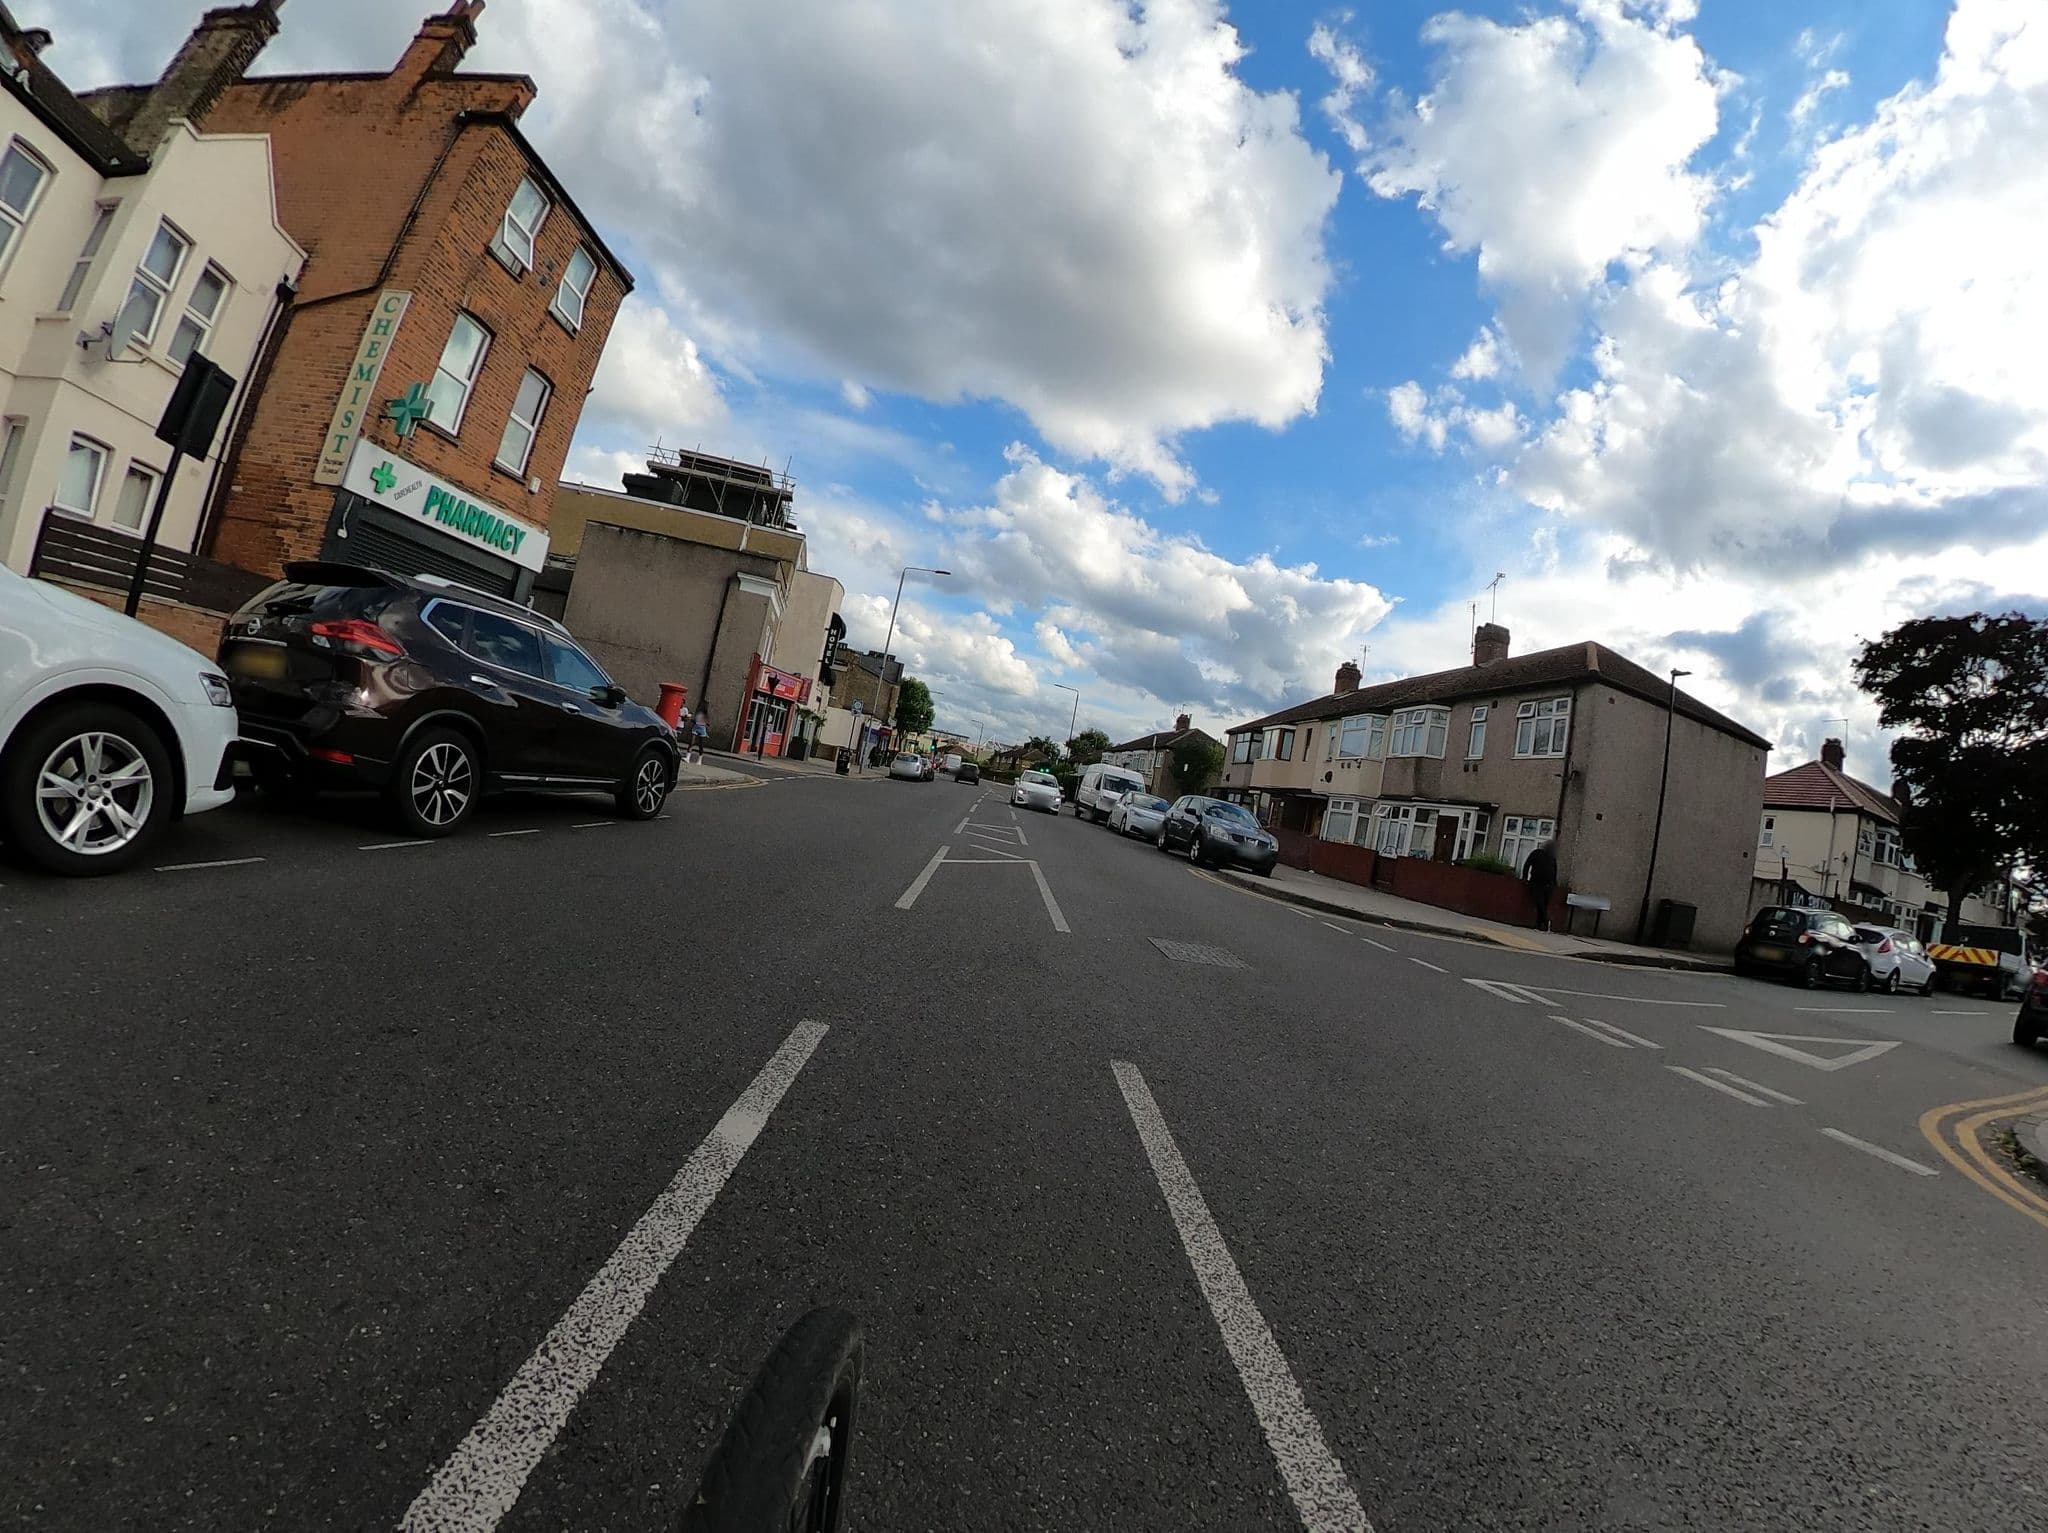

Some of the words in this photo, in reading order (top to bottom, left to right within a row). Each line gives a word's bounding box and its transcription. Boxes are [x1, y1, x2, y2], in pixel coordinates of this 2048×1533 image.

[332, 297, 400, 454] CHEMIST
[422, 485, 527, 555] PHARMACY
[825, 629, 838, 664] HOTEL
